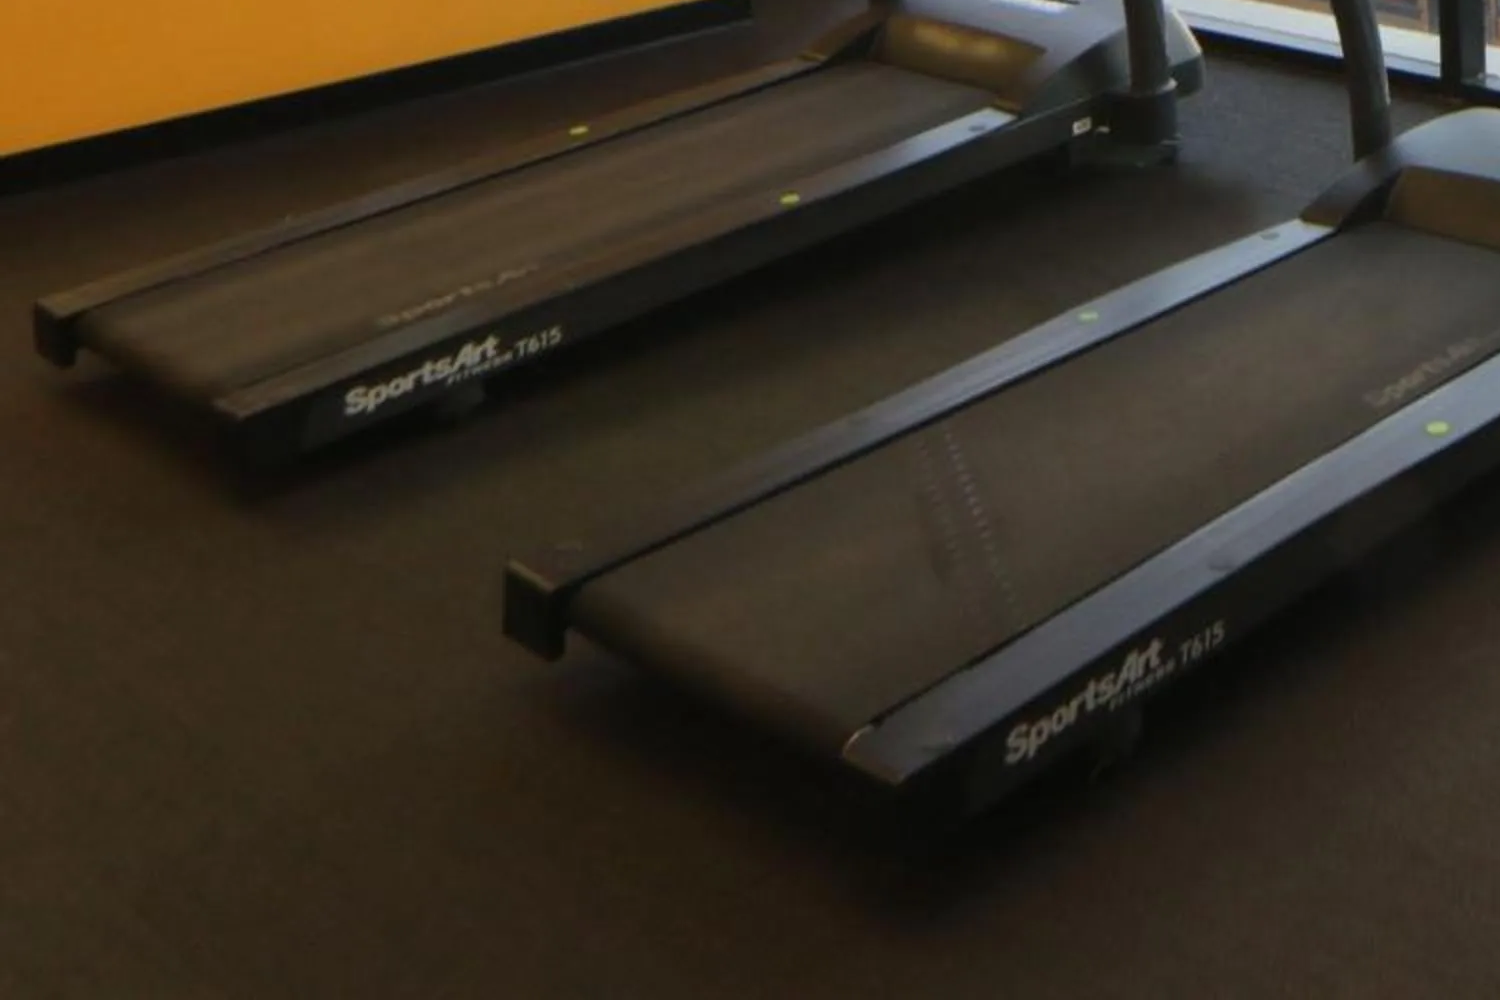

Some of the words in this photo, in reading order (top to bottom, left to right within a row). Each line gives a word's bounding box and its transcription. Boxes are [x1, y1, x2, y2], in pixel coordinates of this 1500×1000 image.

[344, 335, 500, 415] SportsArt
[514, 326, 562, 357] T615
[1004, 637, 1162, 765] SportsArt
[1181, 620, 1225, 664] T615
